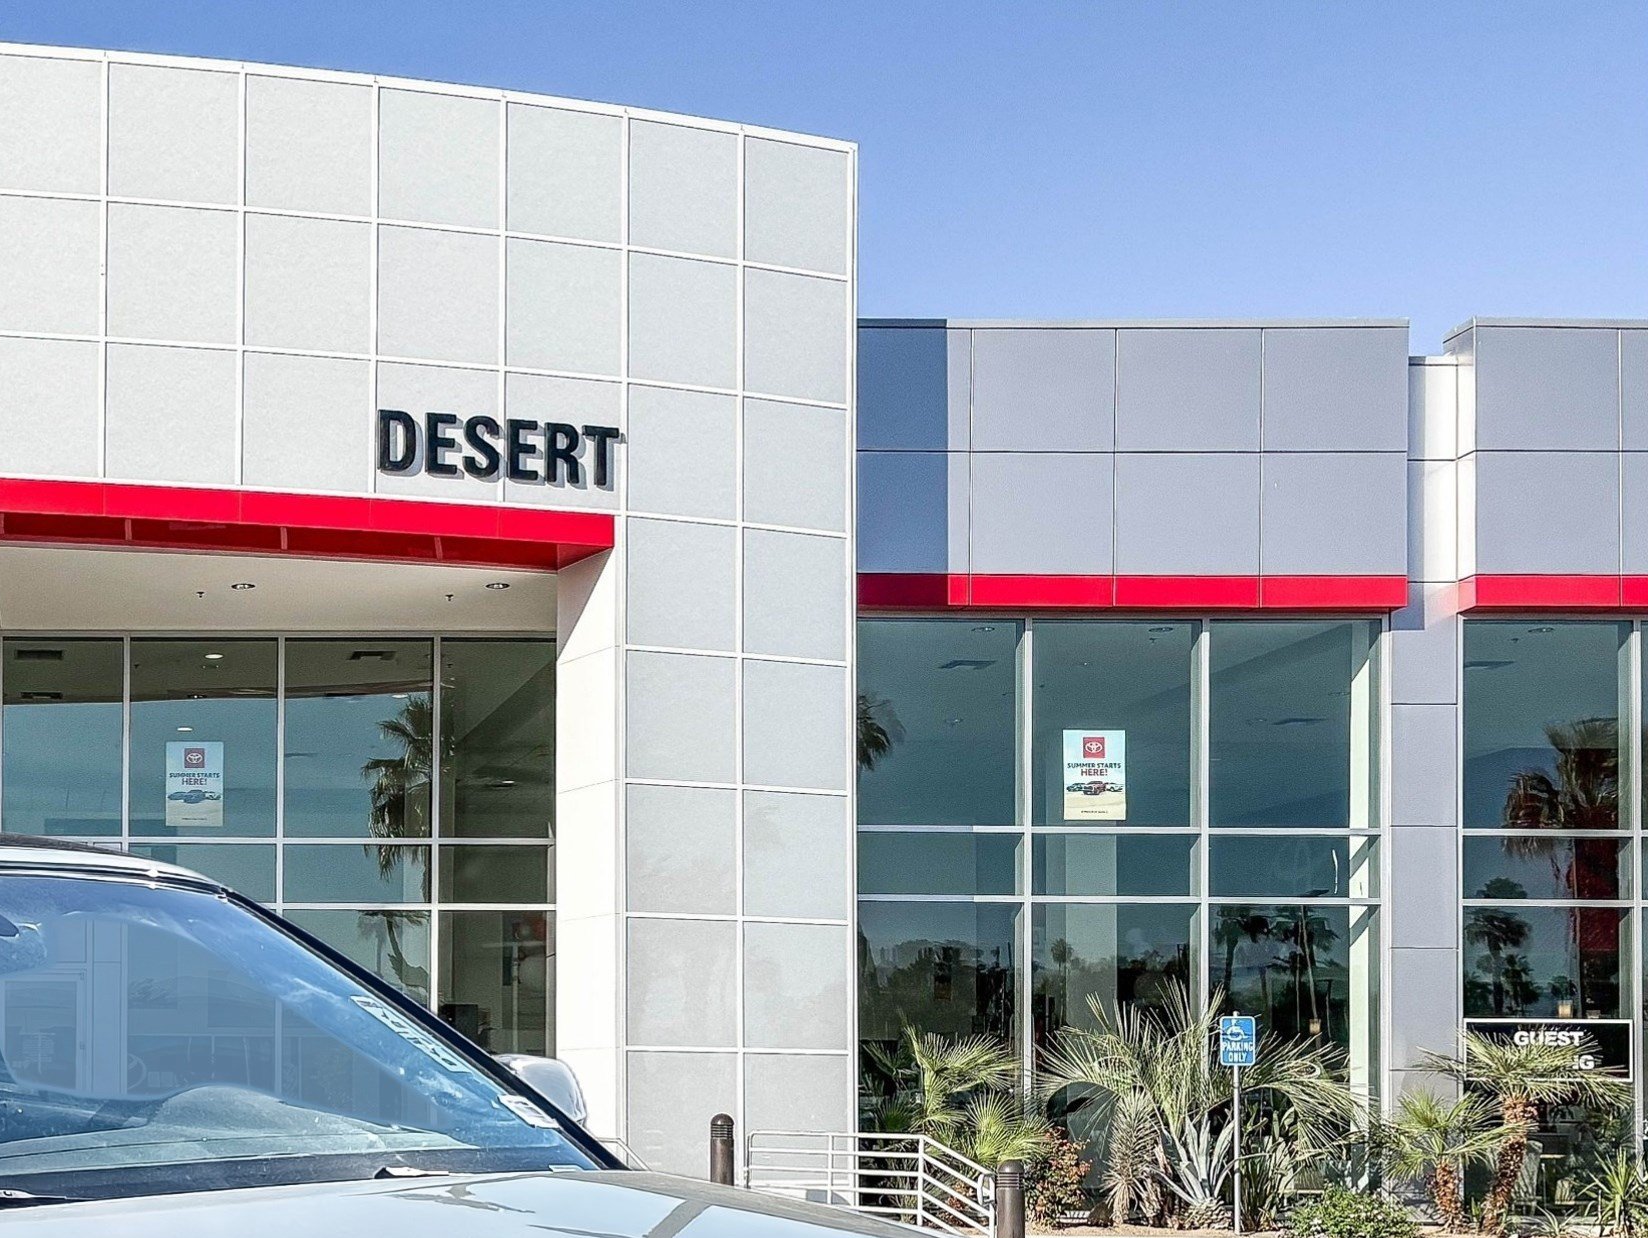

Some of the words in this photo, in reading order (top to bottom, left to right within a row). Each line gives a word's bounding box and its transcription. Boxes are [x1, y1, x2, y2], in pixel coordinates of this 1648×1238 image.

[377, 409, 621, 487] DESERT
[1080, 768, 1108, 776] HERE!
[181, 778, 208, 786] HERE!
[1513, 1030, 1585, 1046] GUEST
[1222, 1041, 1253, 1052] PARKING
[1228, 1051, 1248, 1062] ONLY
